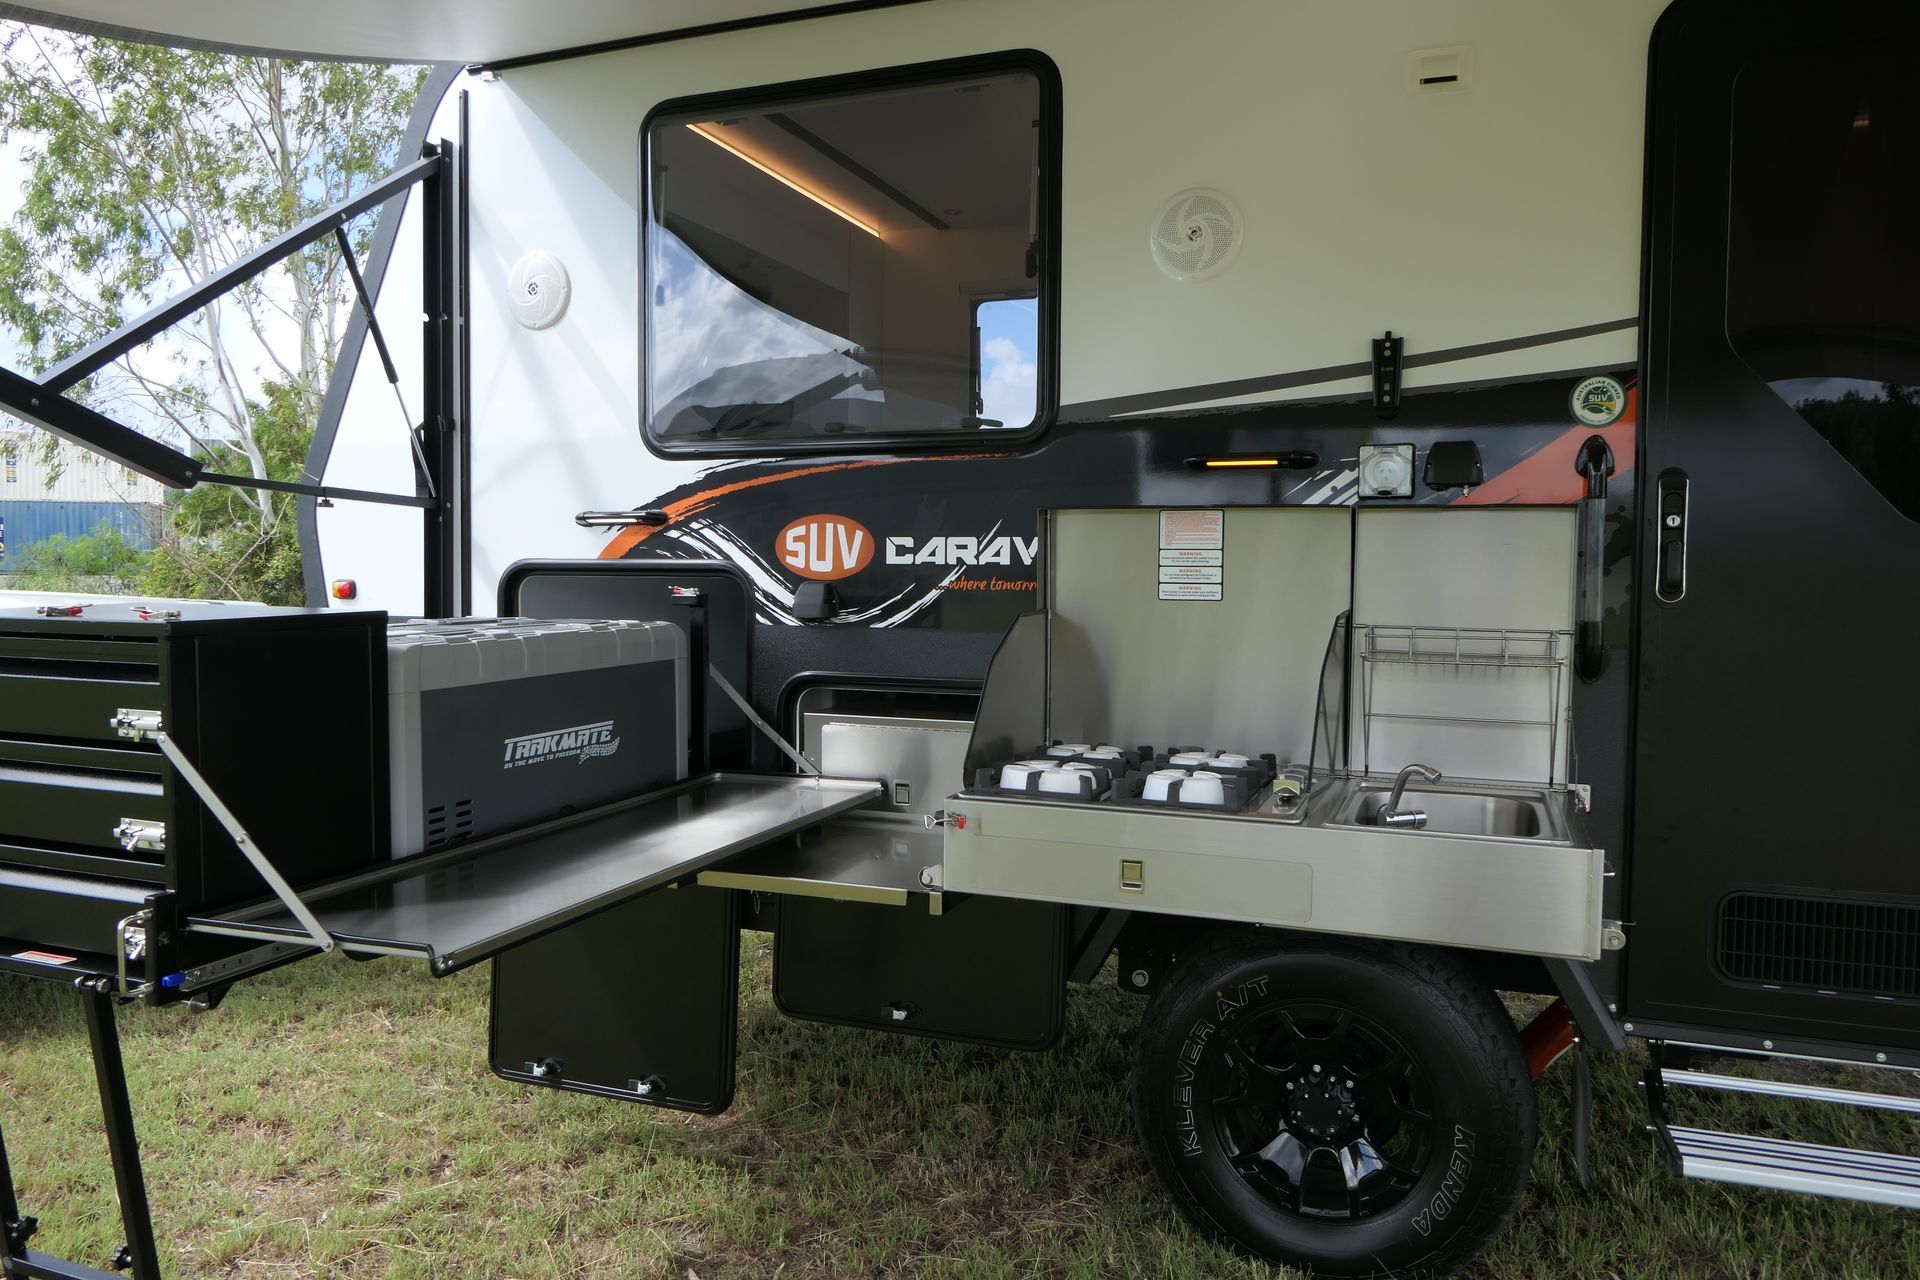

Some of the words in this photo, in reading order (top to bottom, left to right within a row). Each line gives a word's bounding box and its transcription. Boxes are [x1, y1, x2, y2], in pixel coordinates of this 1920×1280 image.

[1576, 380, 1606, 401] AUSTRALIAN
[1606, 382, 1621, 400] OWNED
[1588, 393, 1610, 402] SUV
[785, 521, 864, 573] SUV
[885, 530, 1038, 566] CARAV
[504, 720, 614, 762] TRAKMATE
[504, 762, 513, 770] ON
[528, 756, 545, 765] MOVE
[555, 749, 581, 759] FREEDOM
[1173, 1018, 1217, 1158] KLEVER
[1216, 974, 1270, 1022] A/T
[1411, 1124, 1476, 1237] KENDA
